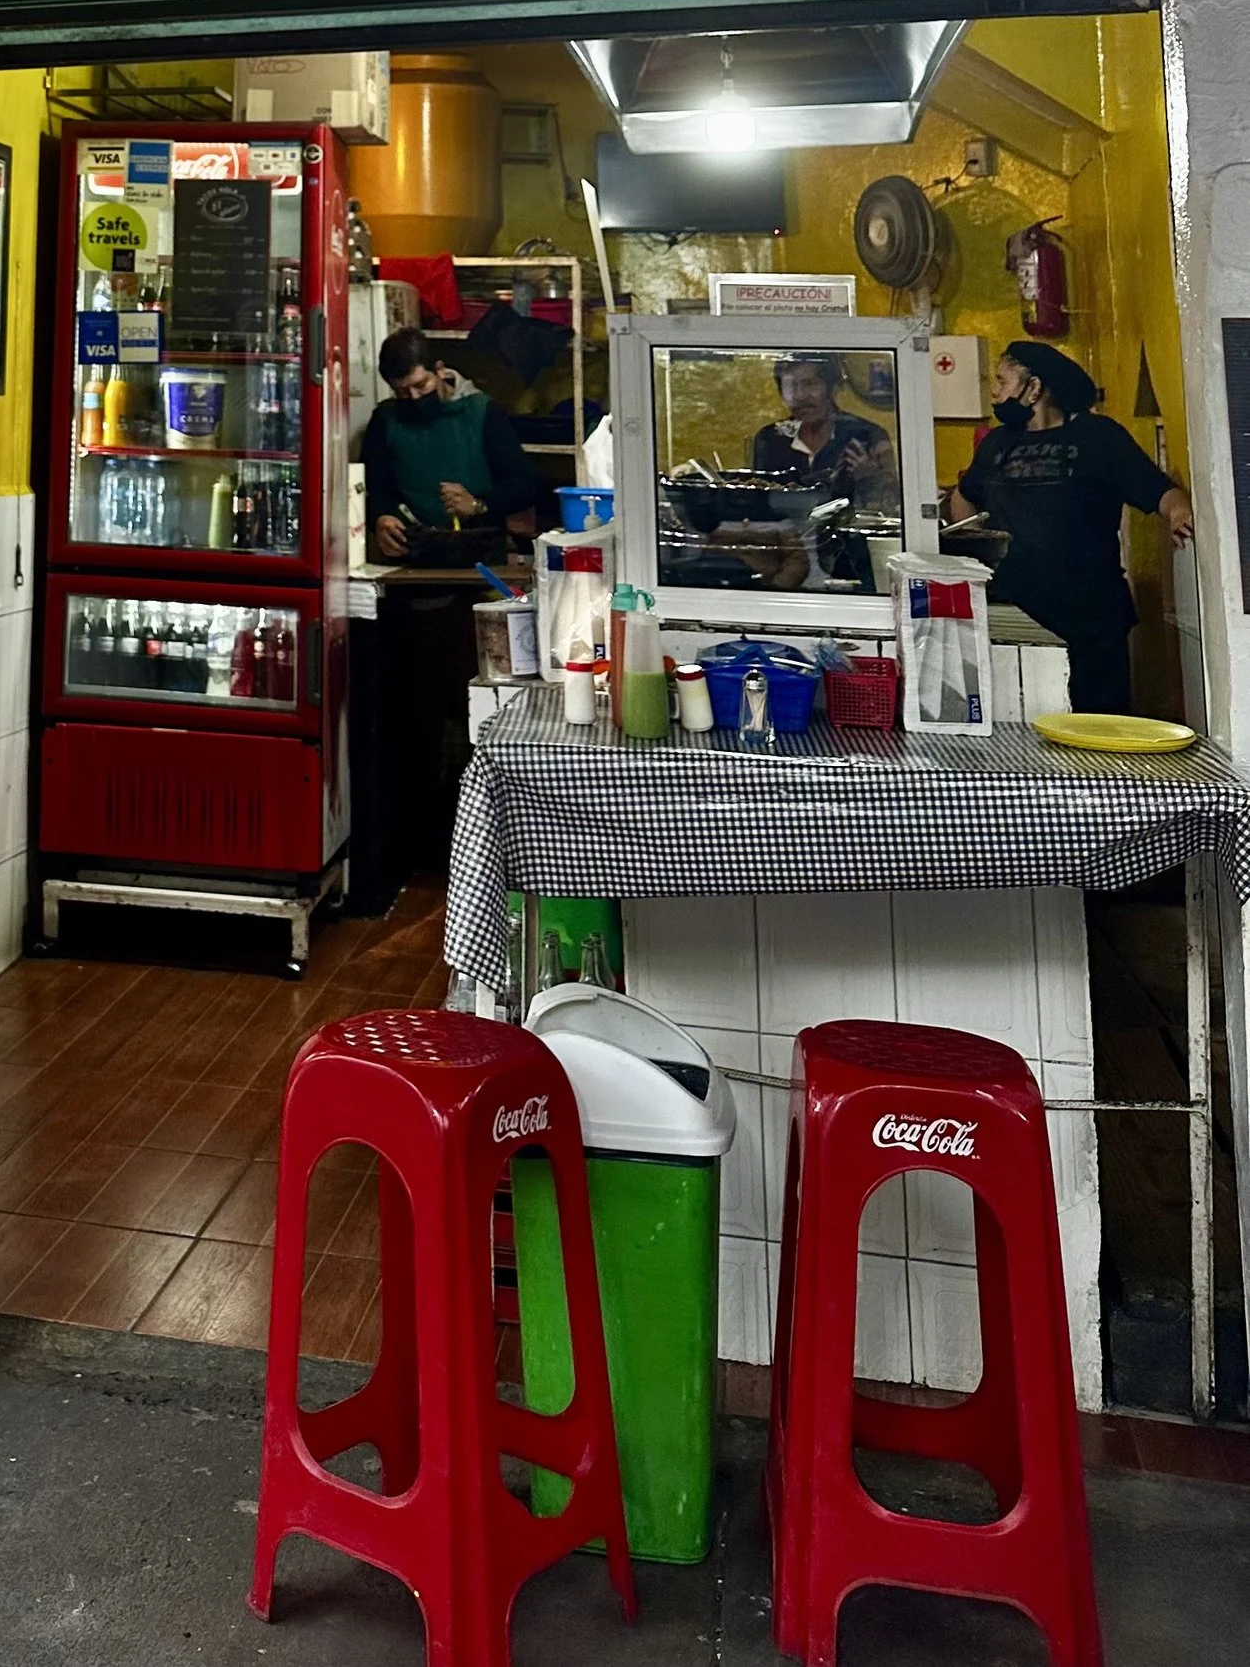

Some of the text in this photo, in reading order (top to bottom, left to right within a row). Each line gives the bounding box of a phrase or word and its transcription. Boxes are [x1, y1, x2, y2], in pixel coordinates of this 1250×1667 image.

[93, 153, 120, 164] VISA
[97, 216, 129, 231] Safe
[88, 231, 140, 245] travels
[121, 326, 158, 339] OPEN
[85, 344, 117, 357] VISA
[971, 697, 980, 721] PLUS
[493, 1095, 548, 1142] Coca-Cola
[872, 1114, 976, 1156] Coca-Cola
